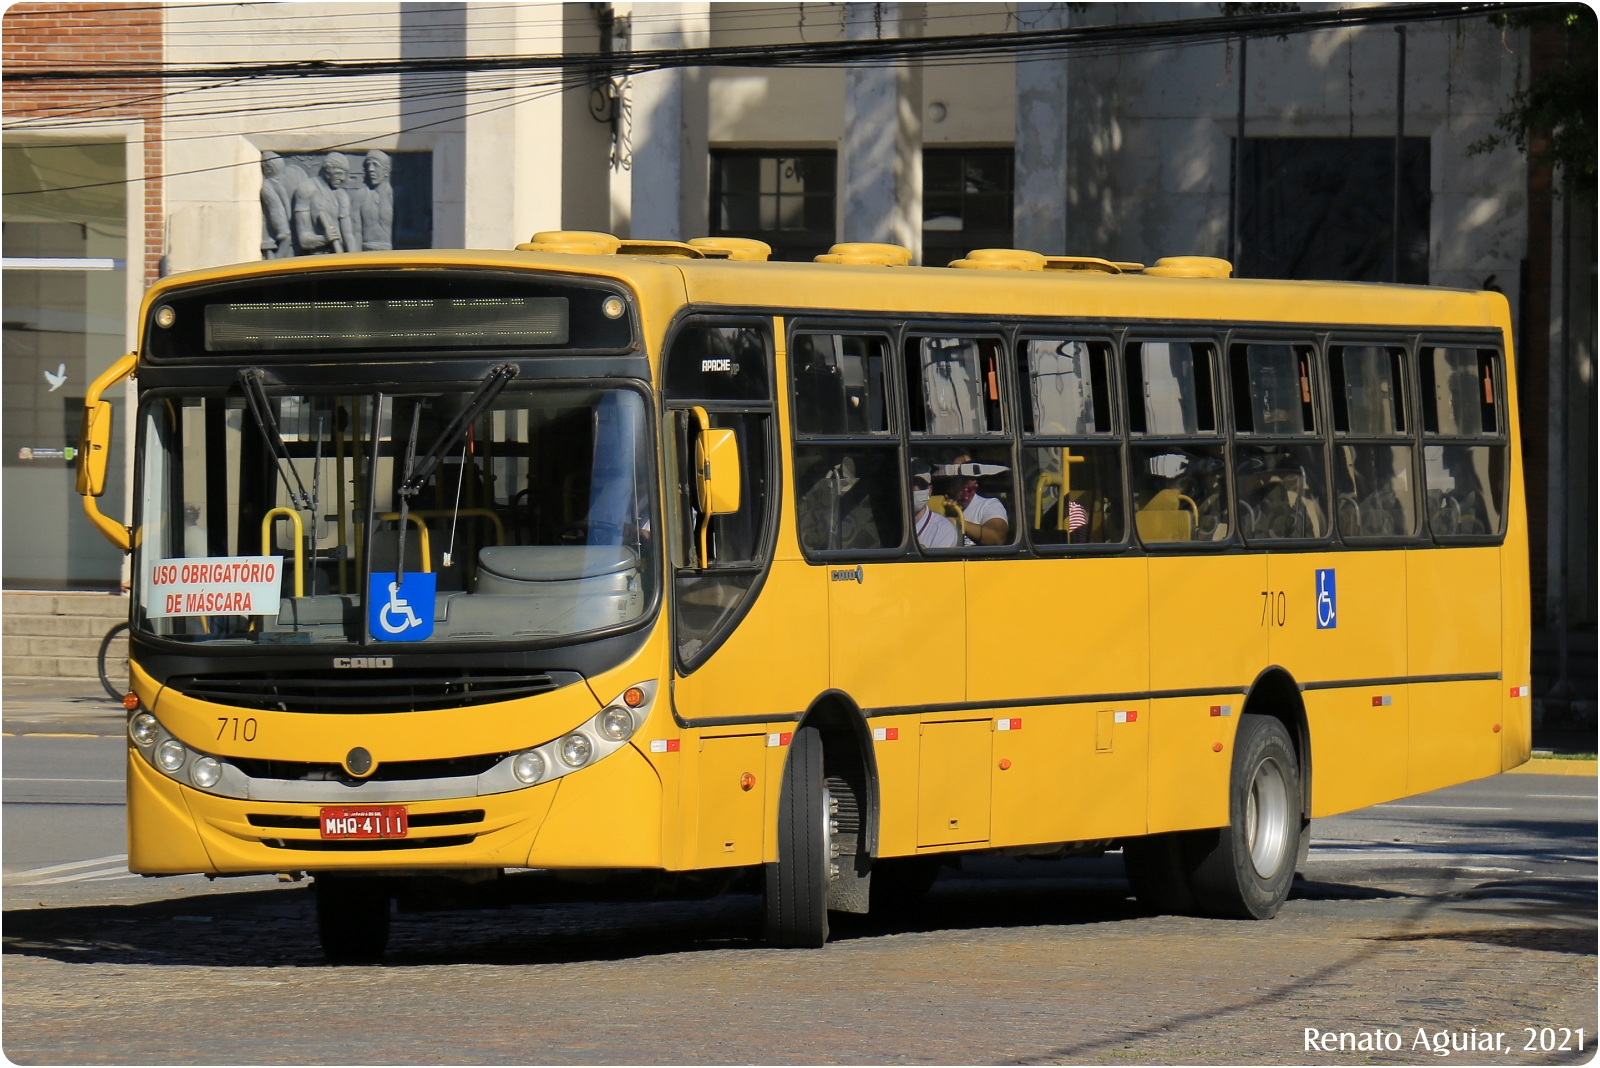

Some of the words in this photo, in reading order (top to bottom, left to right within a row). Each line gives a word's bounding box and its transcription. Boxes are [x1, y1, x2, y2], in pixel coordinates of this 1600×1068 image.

[702, 359, 731, 372] APACHE
[152, 564, 178, 585] USO
[181, 559, 275, 584] OBRIGATÓRIO
[831, 569, 856, 581] CAIO
[165, 593, 183, 614] DE
[185, 588, 252, 612] MÁSCARA
[1260, 590, 1286, 627] 710
[333, 657, 393, 669] CAIO
[216, 717, 258, 742] 710
